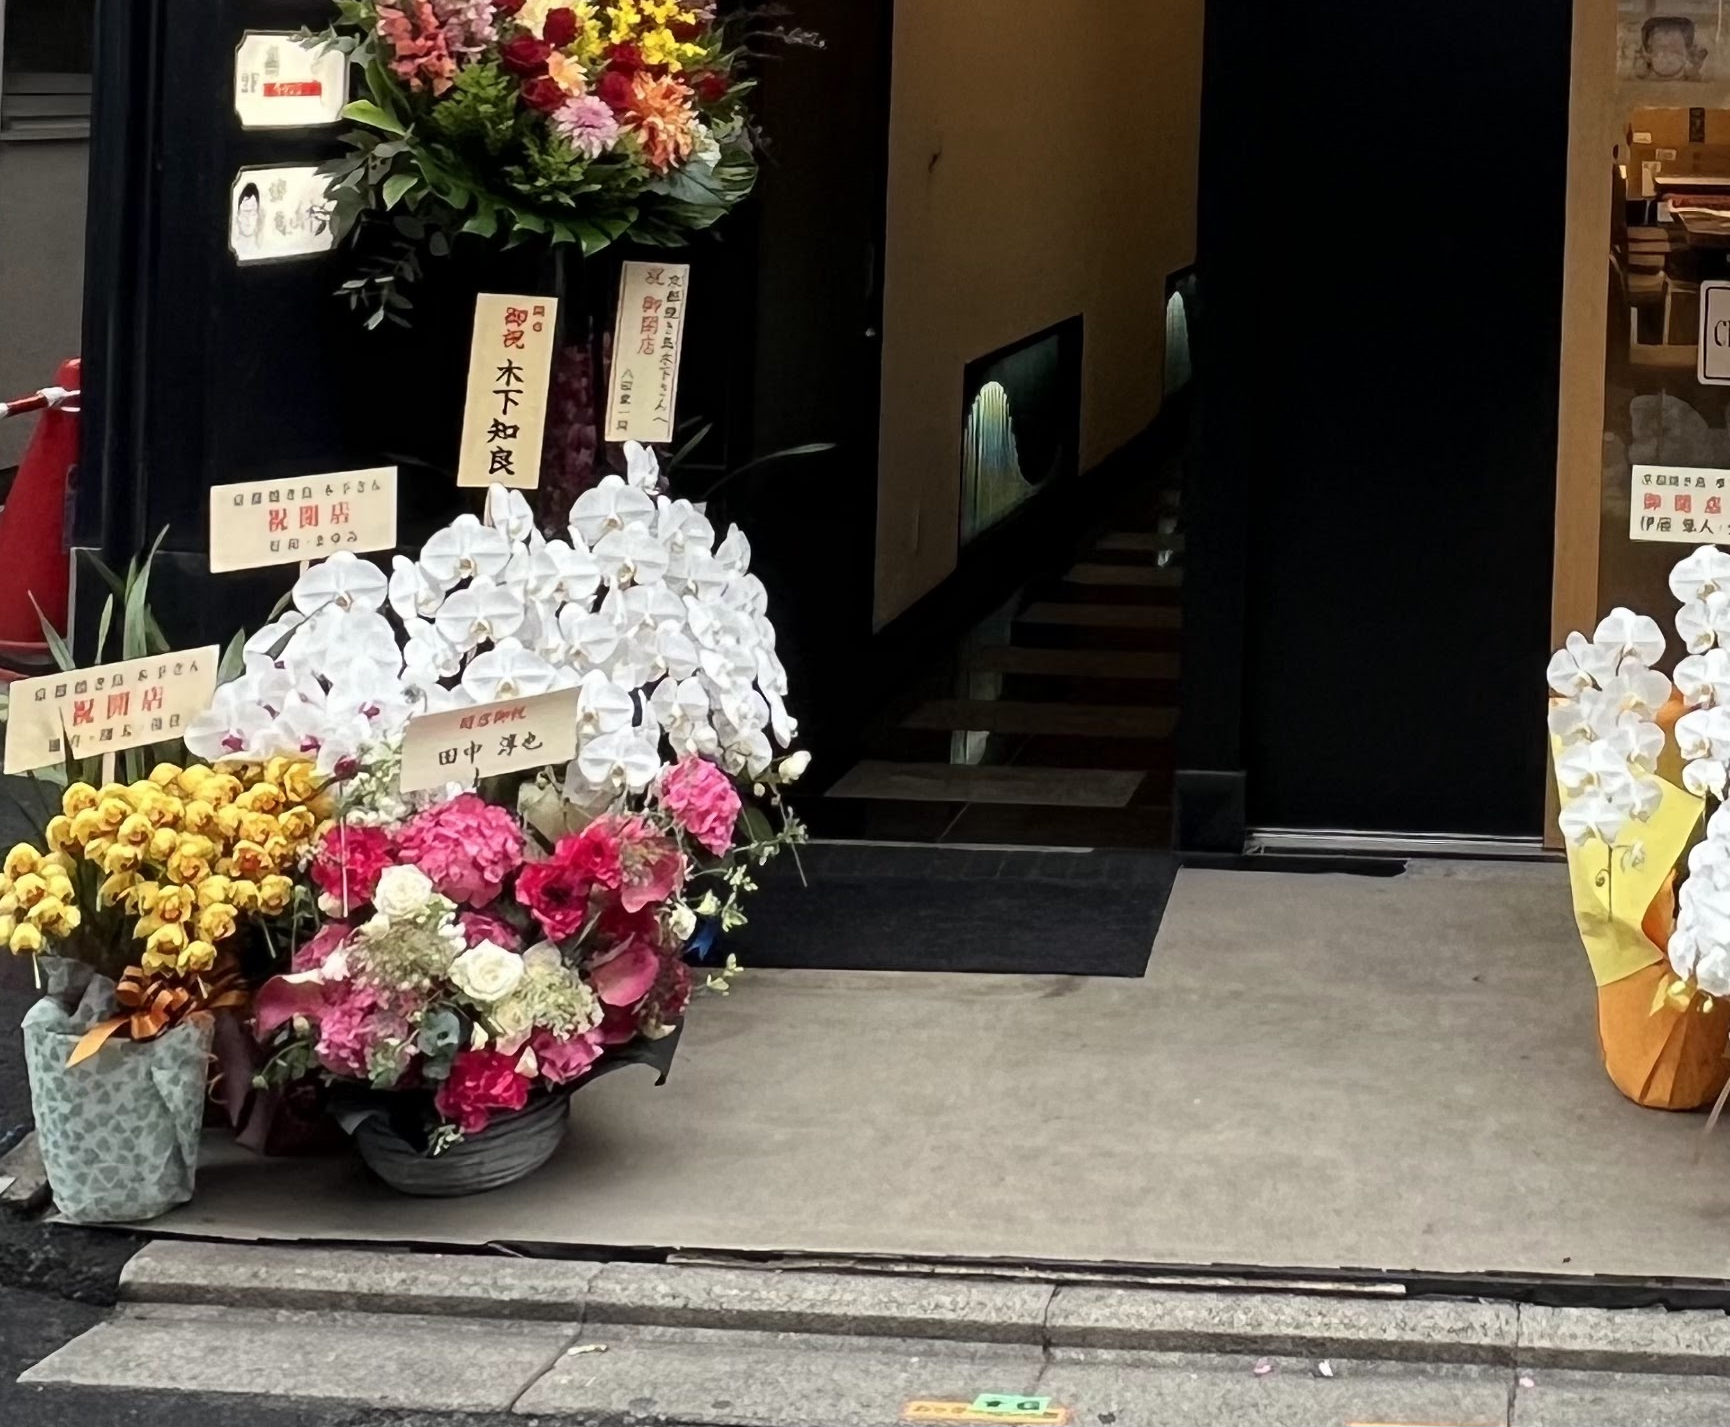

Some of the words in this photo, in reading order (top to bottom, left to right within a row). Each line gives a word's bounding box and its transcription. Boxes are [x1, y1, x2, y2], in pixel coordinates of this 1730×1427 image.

[486, 358, 526, 477] 木下知良
[267, 501, 352, 534] 祝開店
[72, 684, 165, 728] 祝開店
[438, 738, 486, 766] 田中
